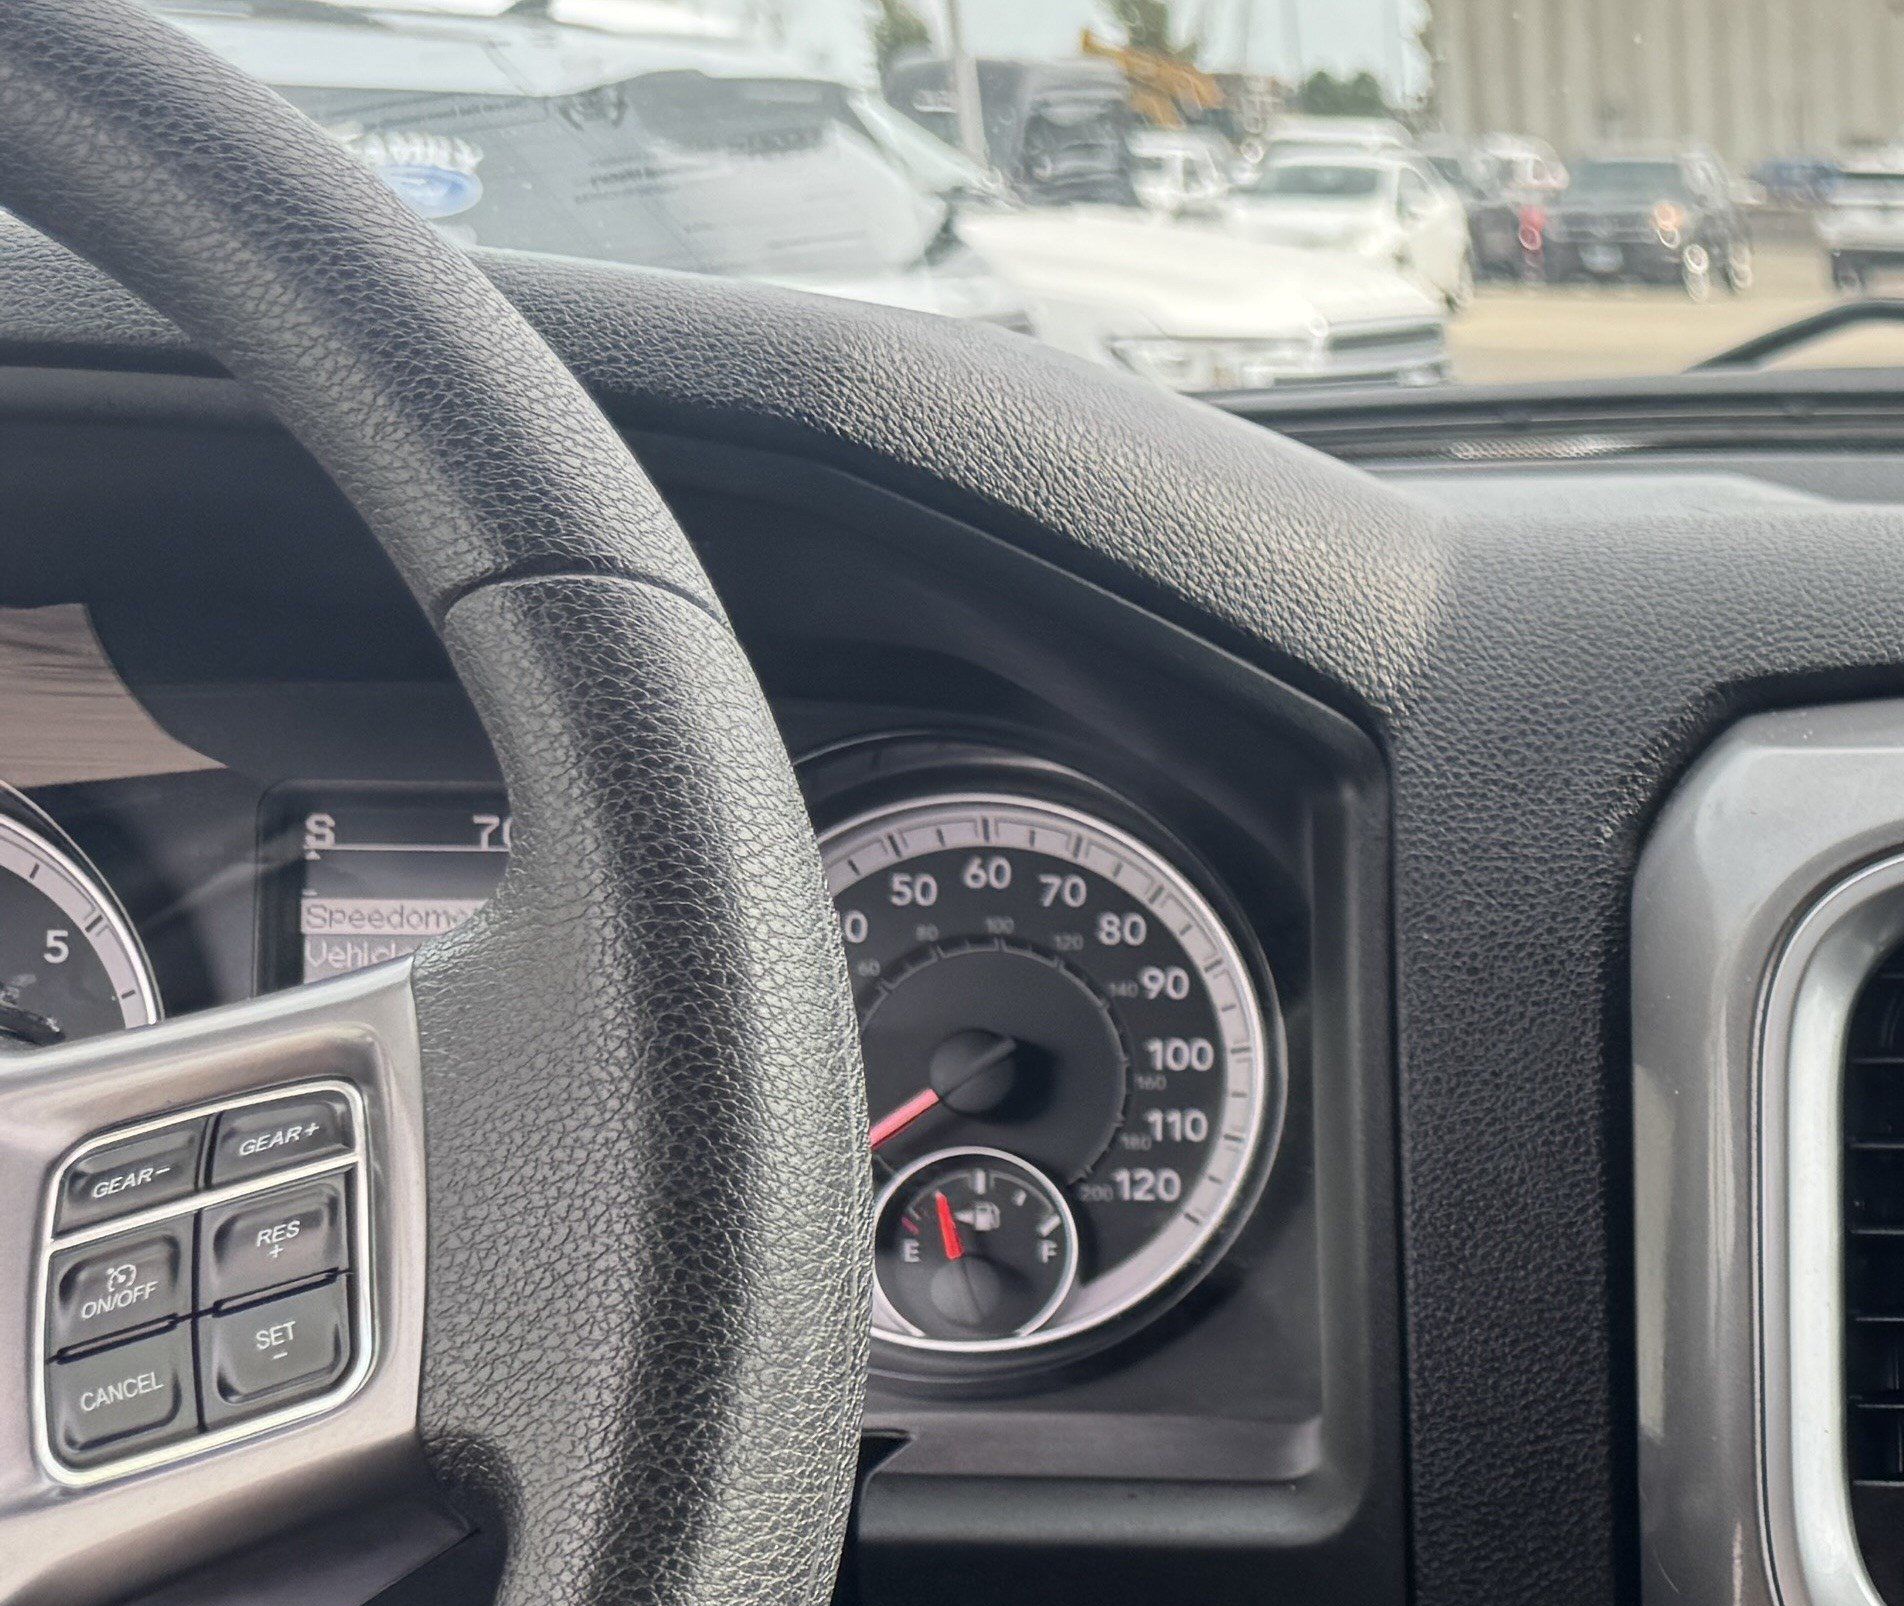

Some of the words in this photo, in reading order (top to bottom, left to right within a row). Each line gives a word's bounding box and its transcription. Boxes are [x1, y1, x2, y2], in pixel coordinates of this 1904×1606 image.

[304, 813, 336, 850] S
[891, 872, 938, 907] 50
[963, 856, 1012, 890] 60
[1038, 874, 1088, 909] 70
[1053, 934, 1084, 951] 120
[1096, 912, 1147, 946] 80
[43, 929, 70, 965] 5
[305, 938, 403, 968] Vehicl
[1109, 981, 1139, 998] 140
[1139, 966, 1190, 1000] 90
[1146, 1037, 1215, 1073] 100
[1145, 1109, 1208, 1143] 110
[1113, 1167, 1182, 1202] 120
[256, 1220, 301, 1249] RES
[903, 1238, 921, 1263] E
[1039, 1239, 1058, 1264] F
[81, 1281, 160, 1320] ON/OFF
[255, 1321, 297, 1351] SET
[80, 1371, 164, 1412] CANCEL
